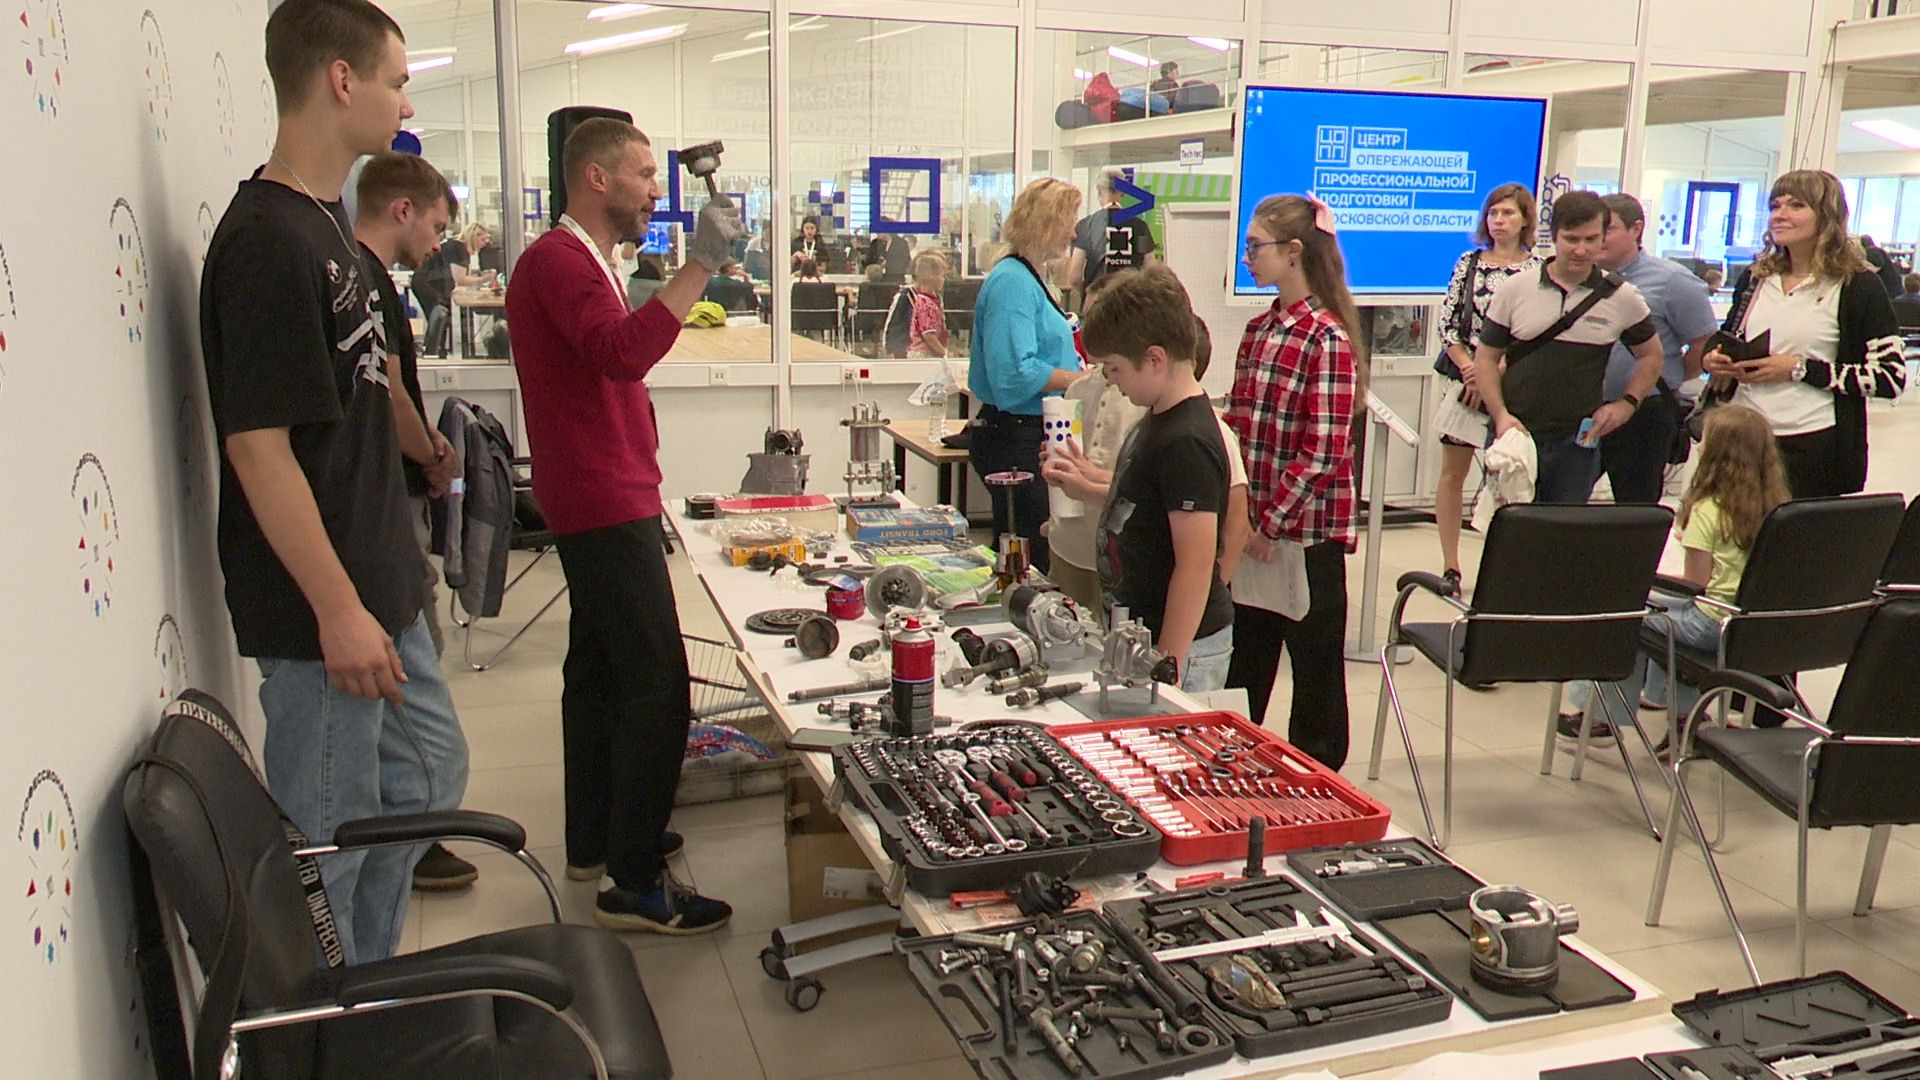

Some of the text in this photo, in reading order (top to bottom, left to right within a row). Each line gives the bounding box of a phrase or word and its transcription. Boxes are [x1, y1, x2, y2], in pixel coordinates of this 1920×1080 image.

[1357, 133, 1401, 147] ЦЕНТР
[1356, 153, 1463, 169] ОПЕРЕЖАЮЩЕЙ
[1320, 172, 1470, 188] ПРОФЕССИОНАЛЬНОЙ
[1320, 192, 1409, 207] ПОДГОТОВКИ
[1413, 213, 1473, 228] ОБЛАСТИ
[1105, 257, 1132, 265] Ростех
[307, 889, 344, 969] UNAFFECTED
